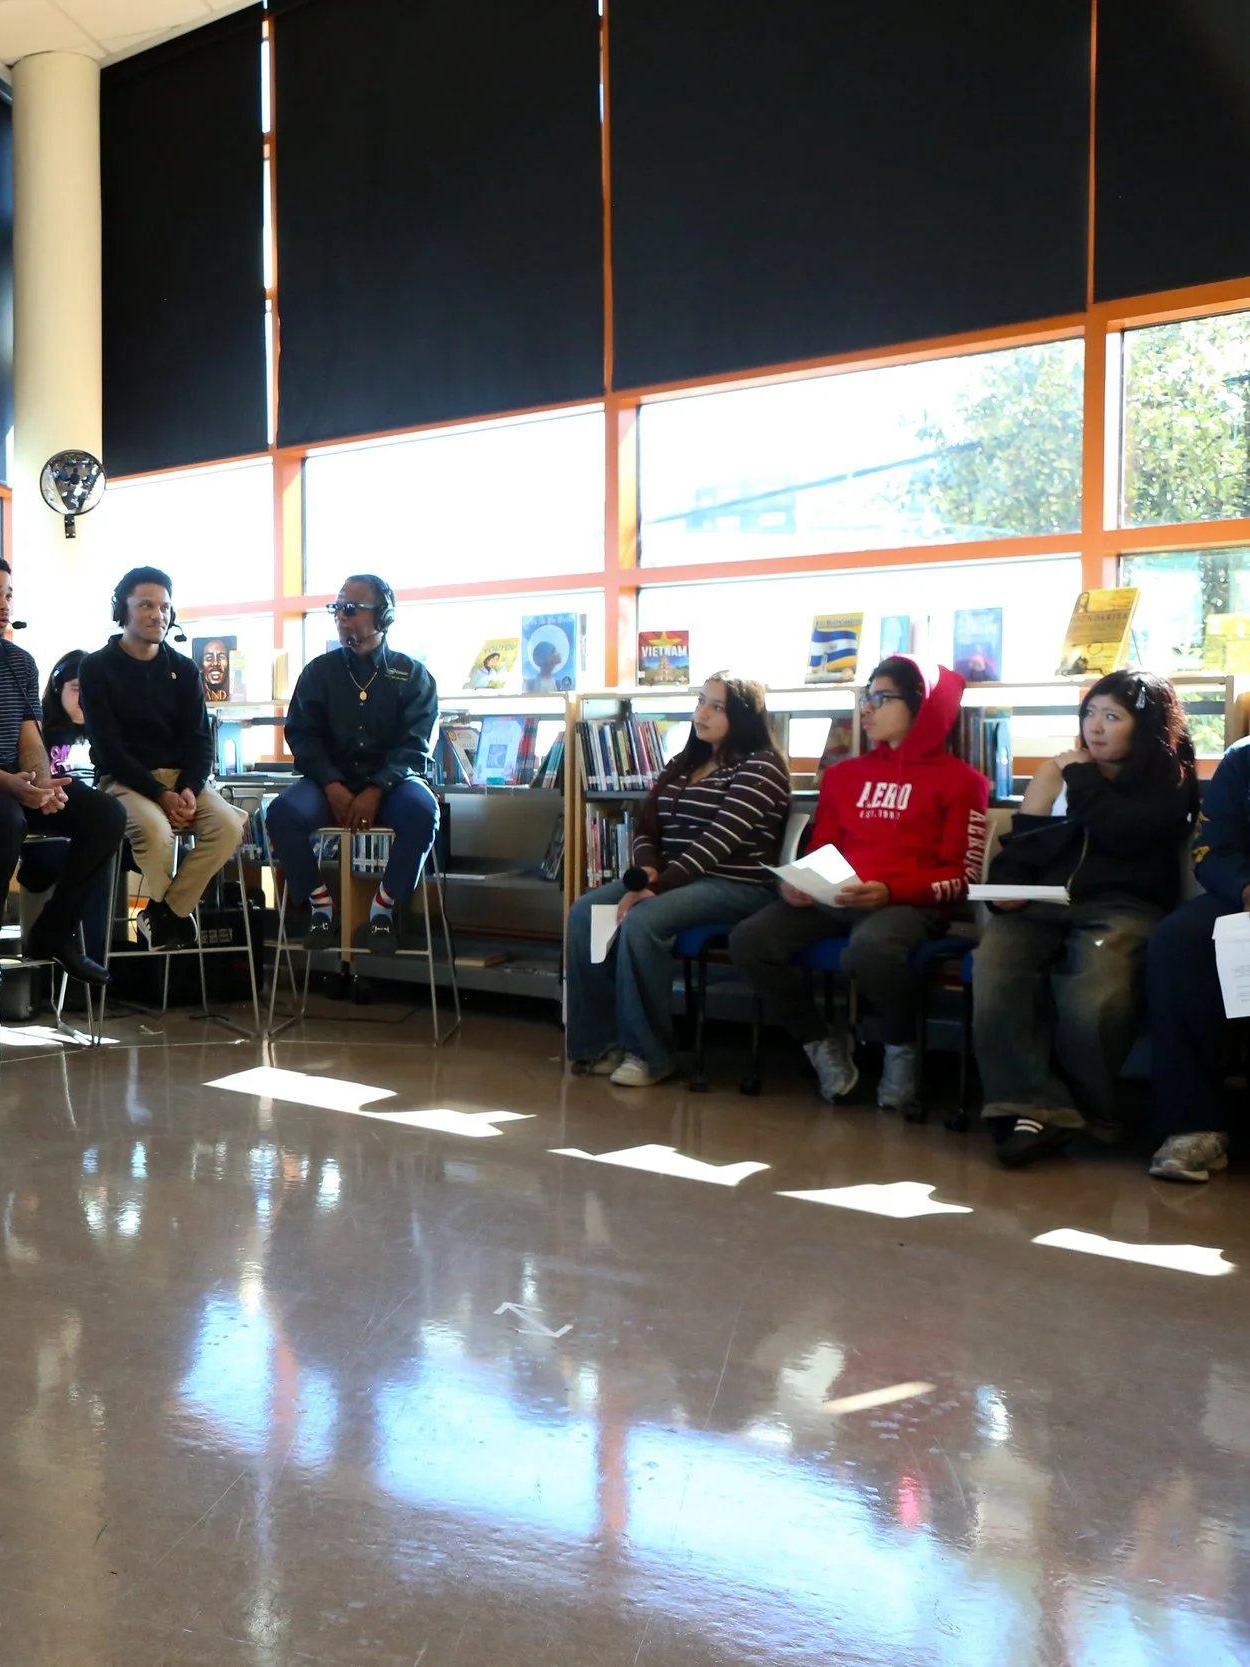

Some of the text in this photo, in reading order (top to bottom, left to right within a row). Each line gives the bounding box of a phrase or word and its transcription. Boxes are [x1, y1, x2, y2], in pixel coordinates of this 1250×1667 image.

[641, 645, 687, 657] VIETNAM
[206, 689, 227, 701] AND
[856, 780, 913, 811] AERO
